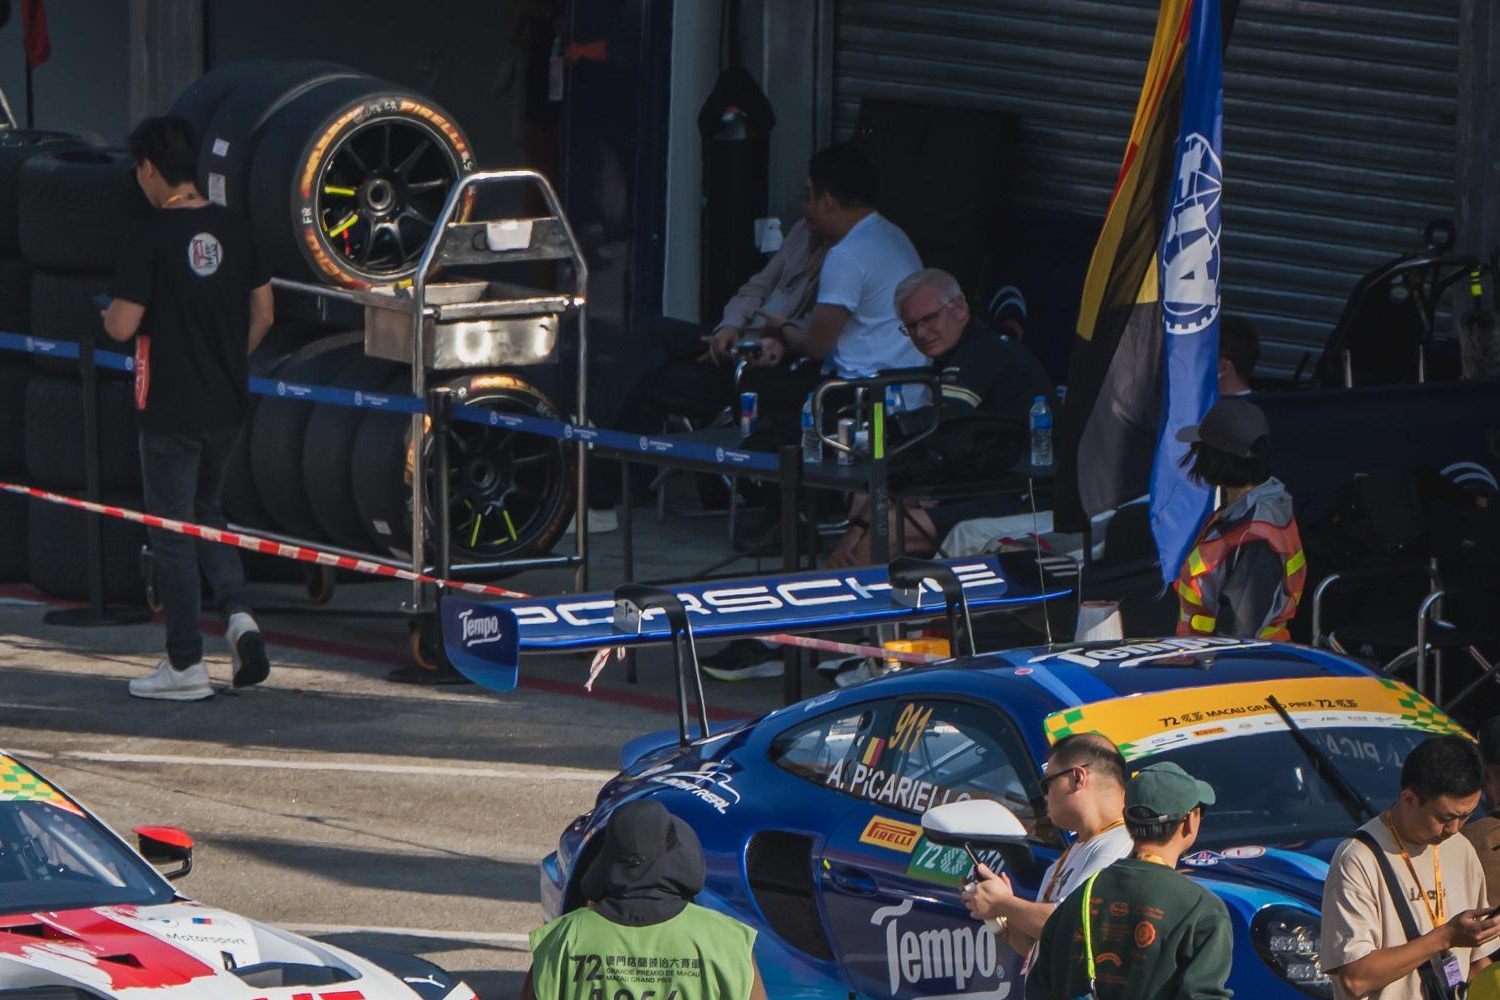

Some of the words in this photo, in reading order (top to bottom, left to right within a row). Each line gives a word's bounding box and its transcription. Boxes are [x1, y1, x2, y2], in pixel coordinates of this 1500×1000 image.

[458, 608, 503, 645] Tempo
[888, 702, 934, 753] 911
[1158, 717, 1181, 728] 72
[1205, 706, 1246, 718] MACAU
[1247, 703, 1288, 713] GRAD
[1315, 699, 1334, 709] 72
[866, 821, 918, 848] PIRELLI
[915, 845, 943, 869] 72
[165, 931, 247, 946] Motorsport
[870, 899, 997, 996] Tempo
[569, 953, 605, 983] 72
